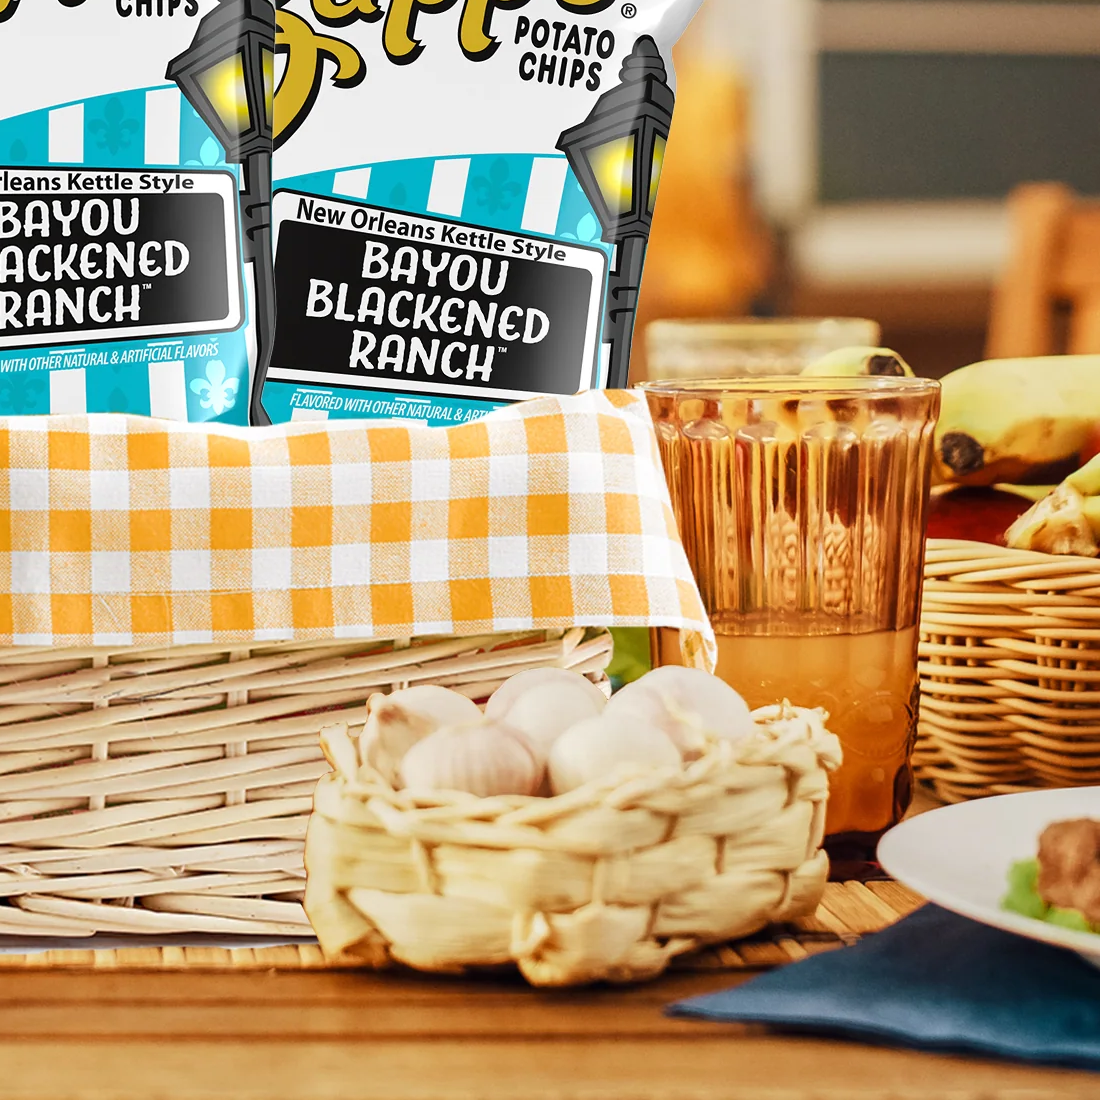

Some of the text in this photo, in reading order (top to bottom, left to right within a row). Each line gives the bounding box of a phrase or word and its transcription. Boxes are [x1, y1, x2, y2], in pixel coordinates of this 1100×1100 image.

[514, 16, 615, 59] POTATO
[519, 57, 602, 91] CHIPS
[67, 173, 133, 191] Kettle
[140, 174, 194, 194] Style
[296, 198, 567, 262] New Orleans Kettle Style
[362, 240, 509, 296] BAYOU
[306, 278, 550, 344] BLACKENED
[0, 357, 28, 373] WITH
[29, 355, 61, 371] OTHER
[63, 351, 111, 368] NATURAL
[110, 350, 119, 363] &
[118, 346, 174, 364] ARTIFICIAL
[174, 343, 219, 360] FLAVORS
[349, 330, 495, 382] RANCH
[289, 393, 342, 411] FLAVORED
[344, 397, 372, 413] WITH
[372, 401, 407, 416] OTHER
[406, 404, 453, 421] NATURAL
[453, 408, 463, 421] &
